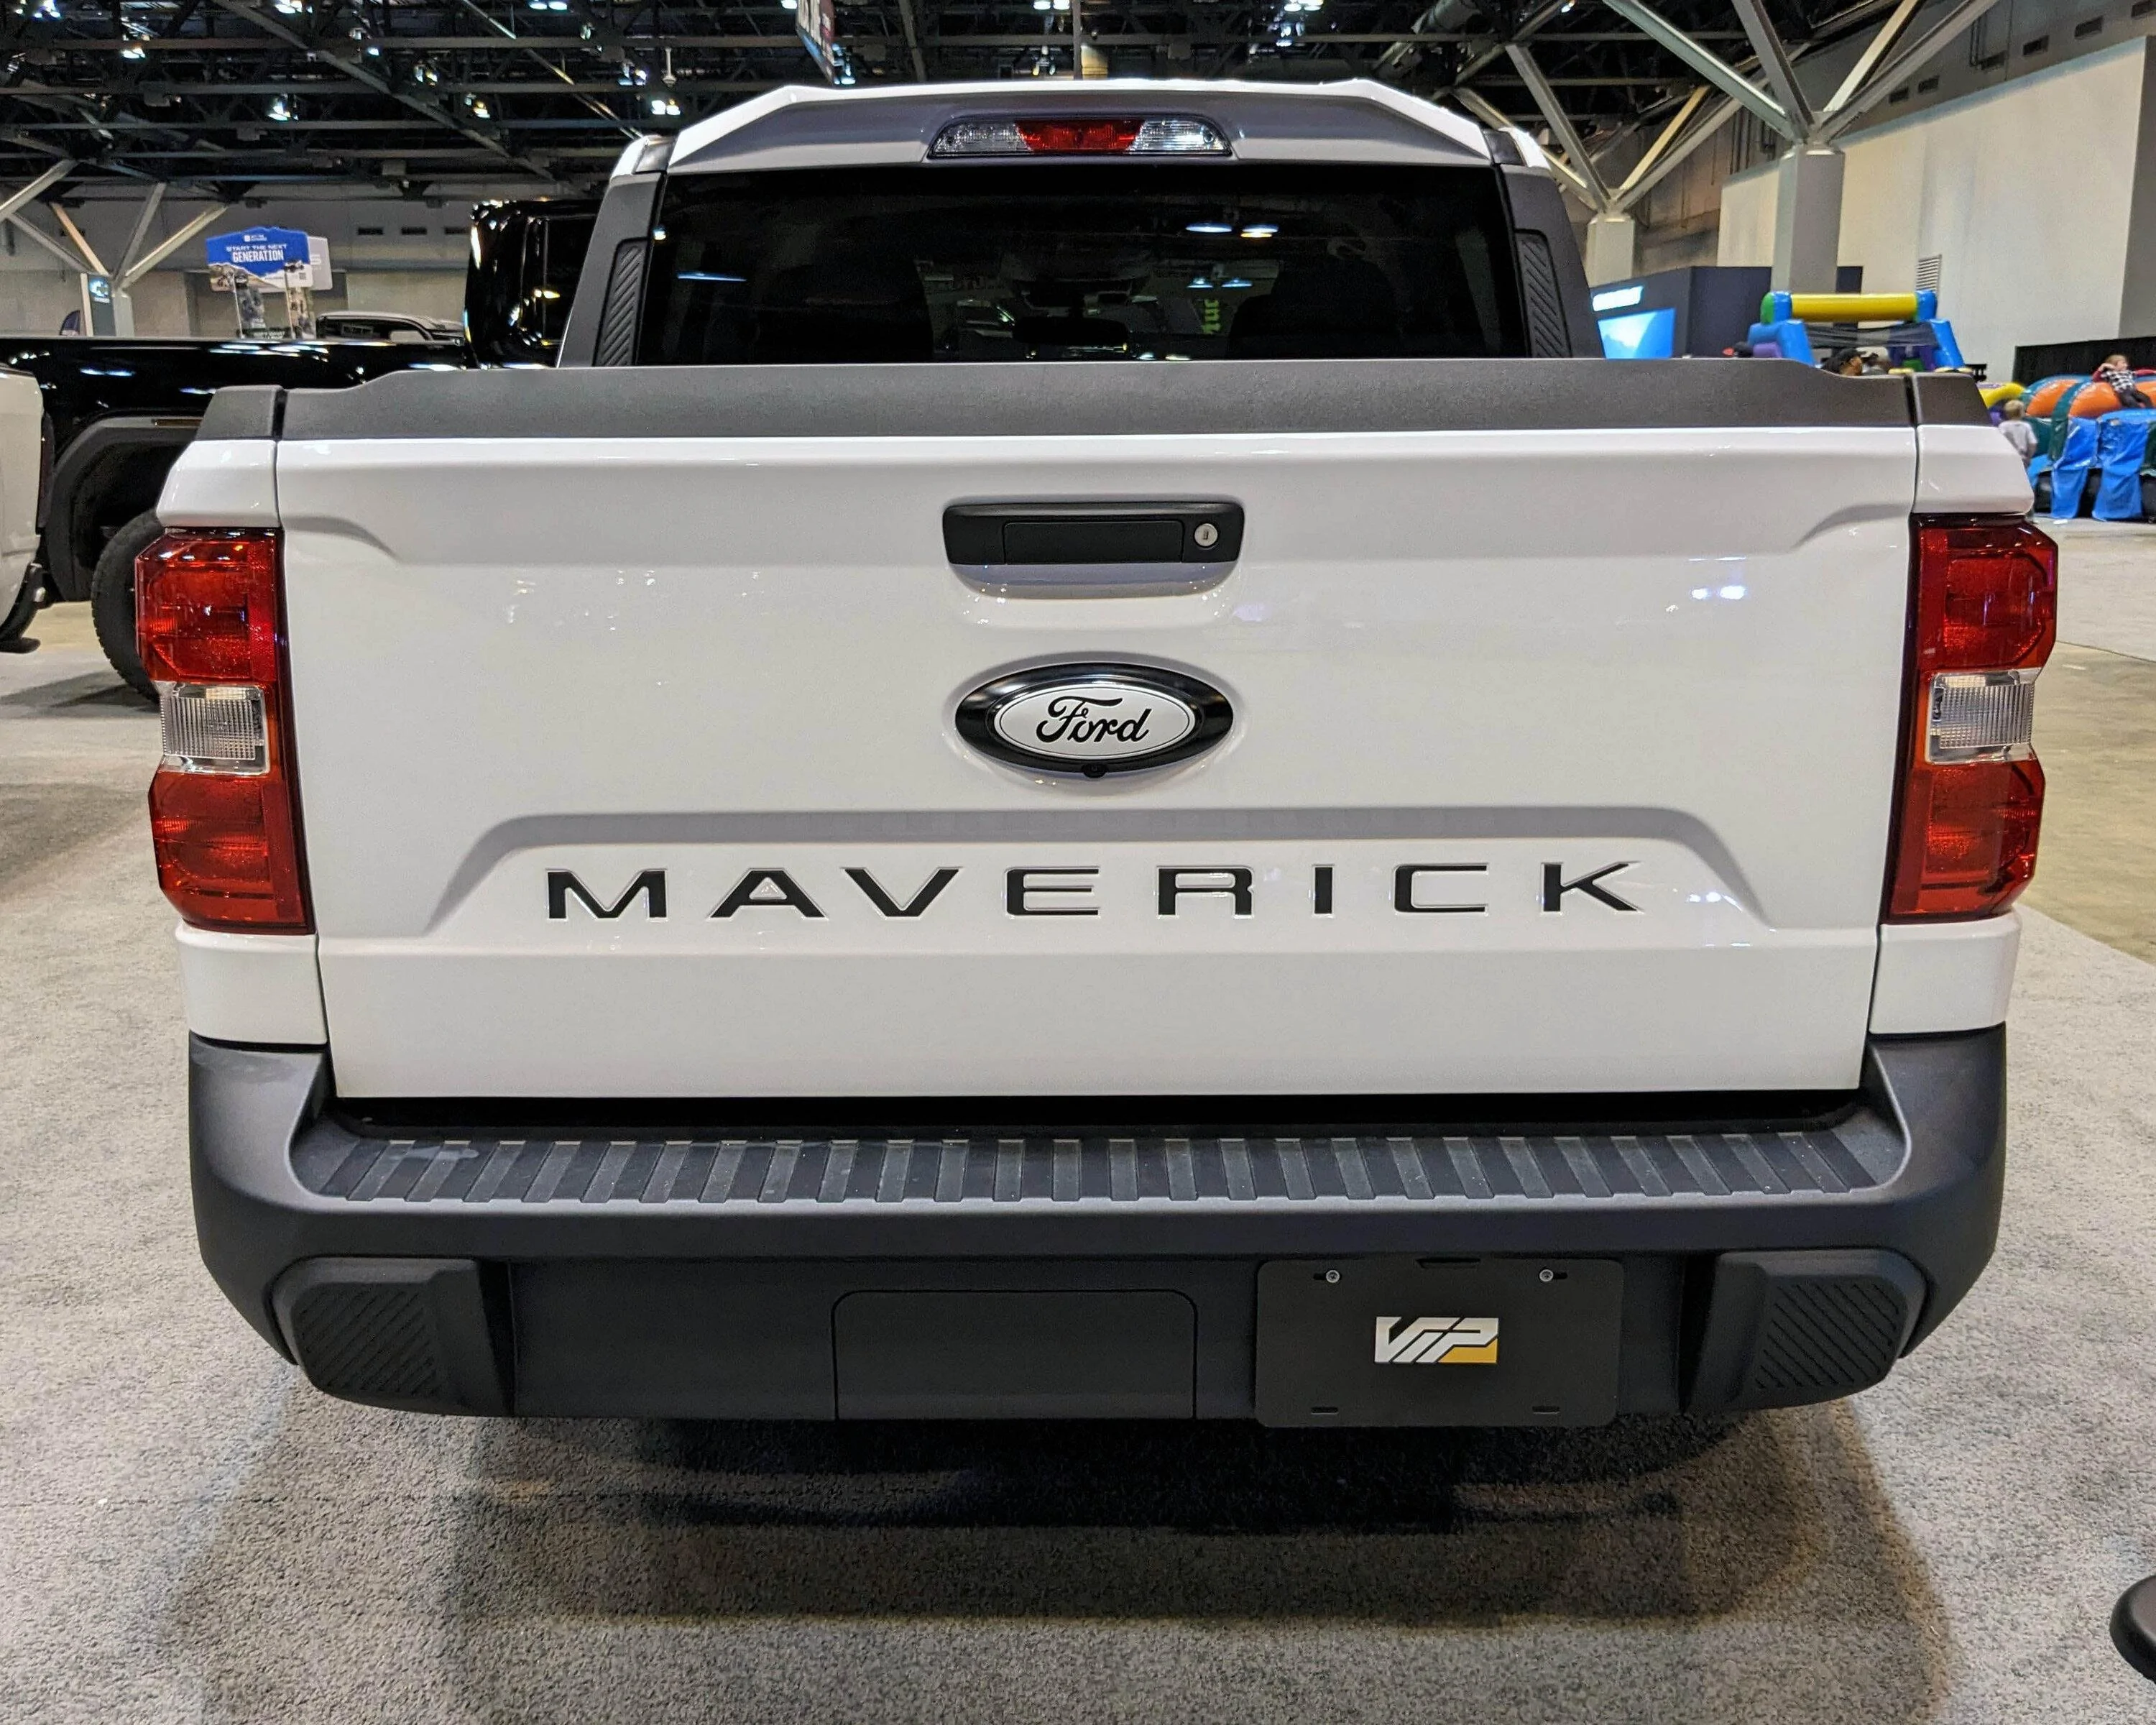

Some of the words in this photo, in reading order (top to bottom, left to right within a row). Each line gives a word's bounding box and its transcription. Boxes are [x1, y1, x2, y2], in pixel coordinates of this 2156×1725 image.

[232, 249, 284, 263] GENERATION
[1036, 695, 1152, 743] Ford
[547, 862, 1640, 920] MAVERICK
[1374, 1316, 1499, 1363] VIP
